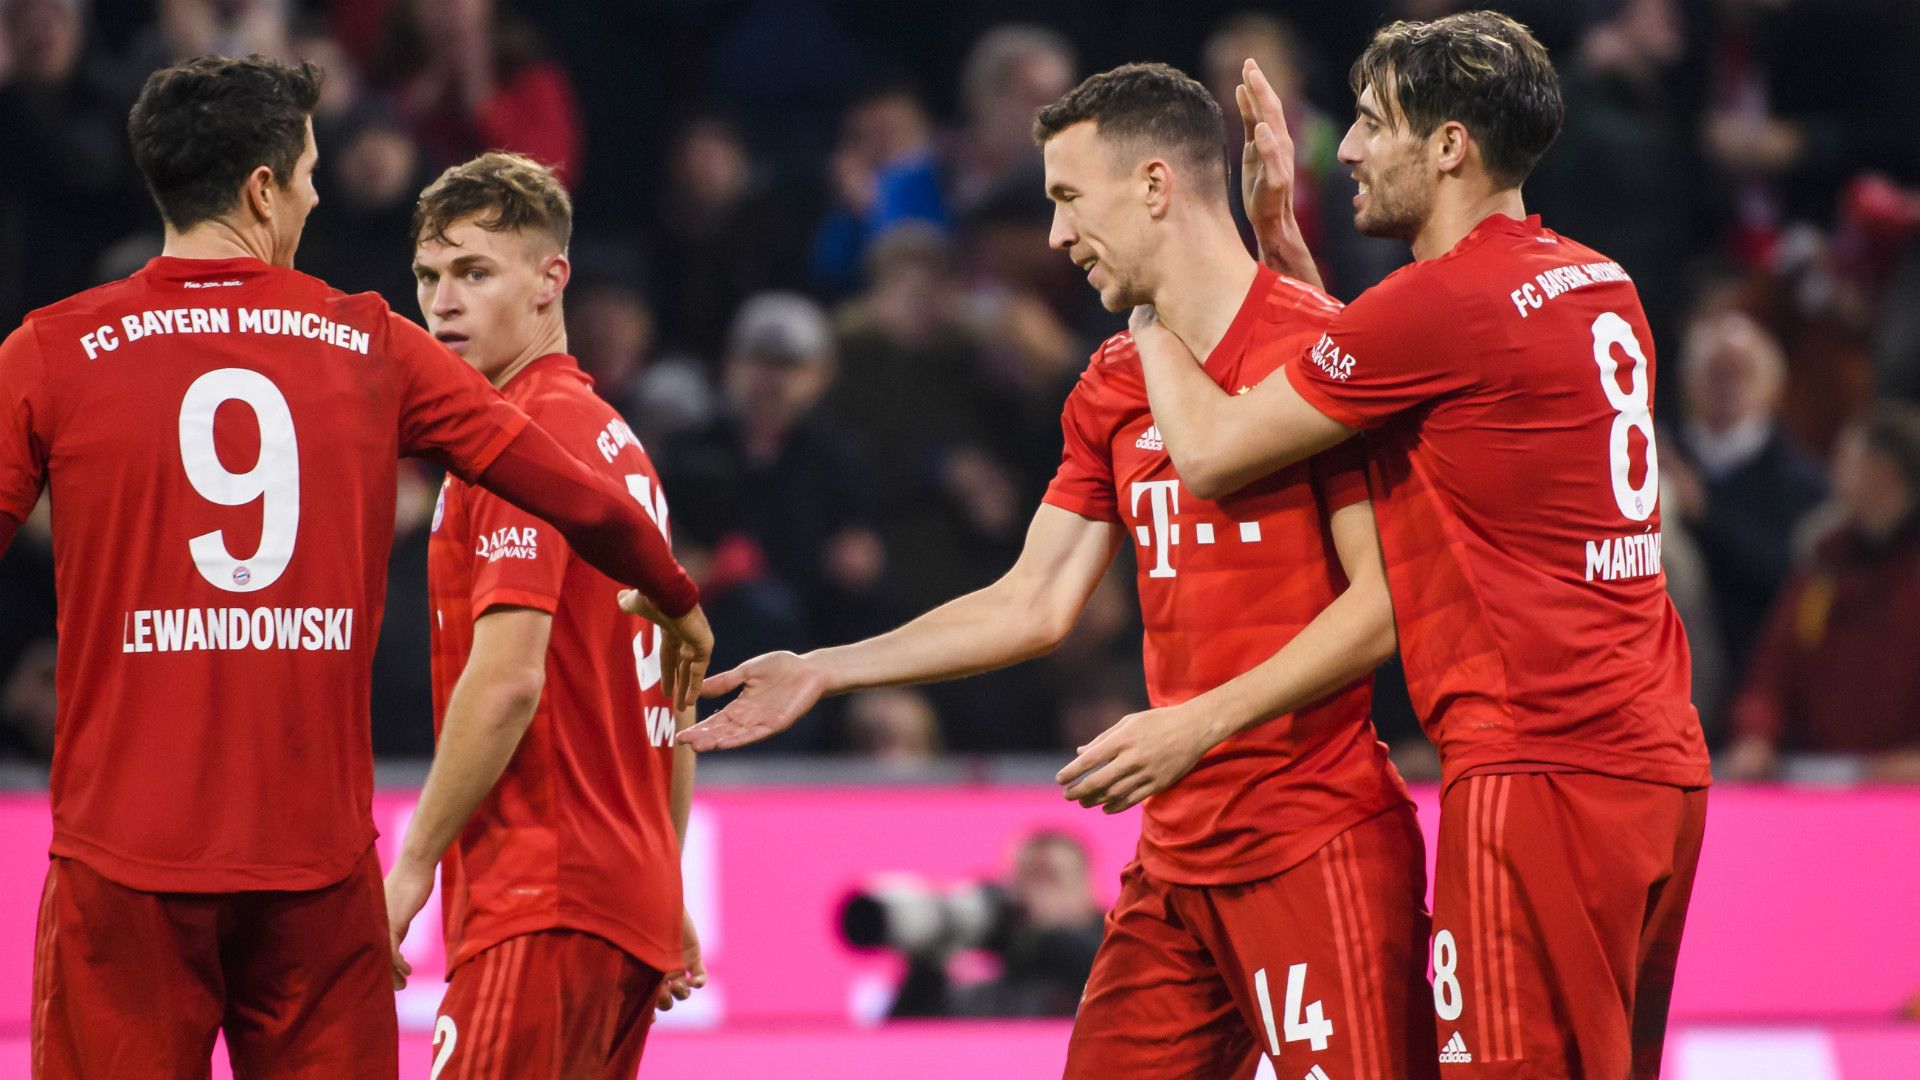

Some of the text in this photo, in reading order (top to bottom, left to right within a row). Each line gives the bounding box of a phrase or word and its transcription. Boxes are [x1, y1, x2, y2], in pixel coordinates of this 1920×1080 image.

[1510, 282, 1543, 318] FC
[80, 307, 370, 360] FC BAYERN MÜNCHEN
[1591, 311, 1659, 522] 8
[596, 430, 619, 464] FC
[1135, 437, 1164, 451] adidas
[178, 367, 300, 593] 9
[476, 526, 537, 558] QATAR
[1586, 524, 1661, 581] MARTÍN
[1433, 929, 1463, 1021] 8
[1254, 962, 1334, 1056] 14
[1438, 1050, 1472, 1063] adidas
